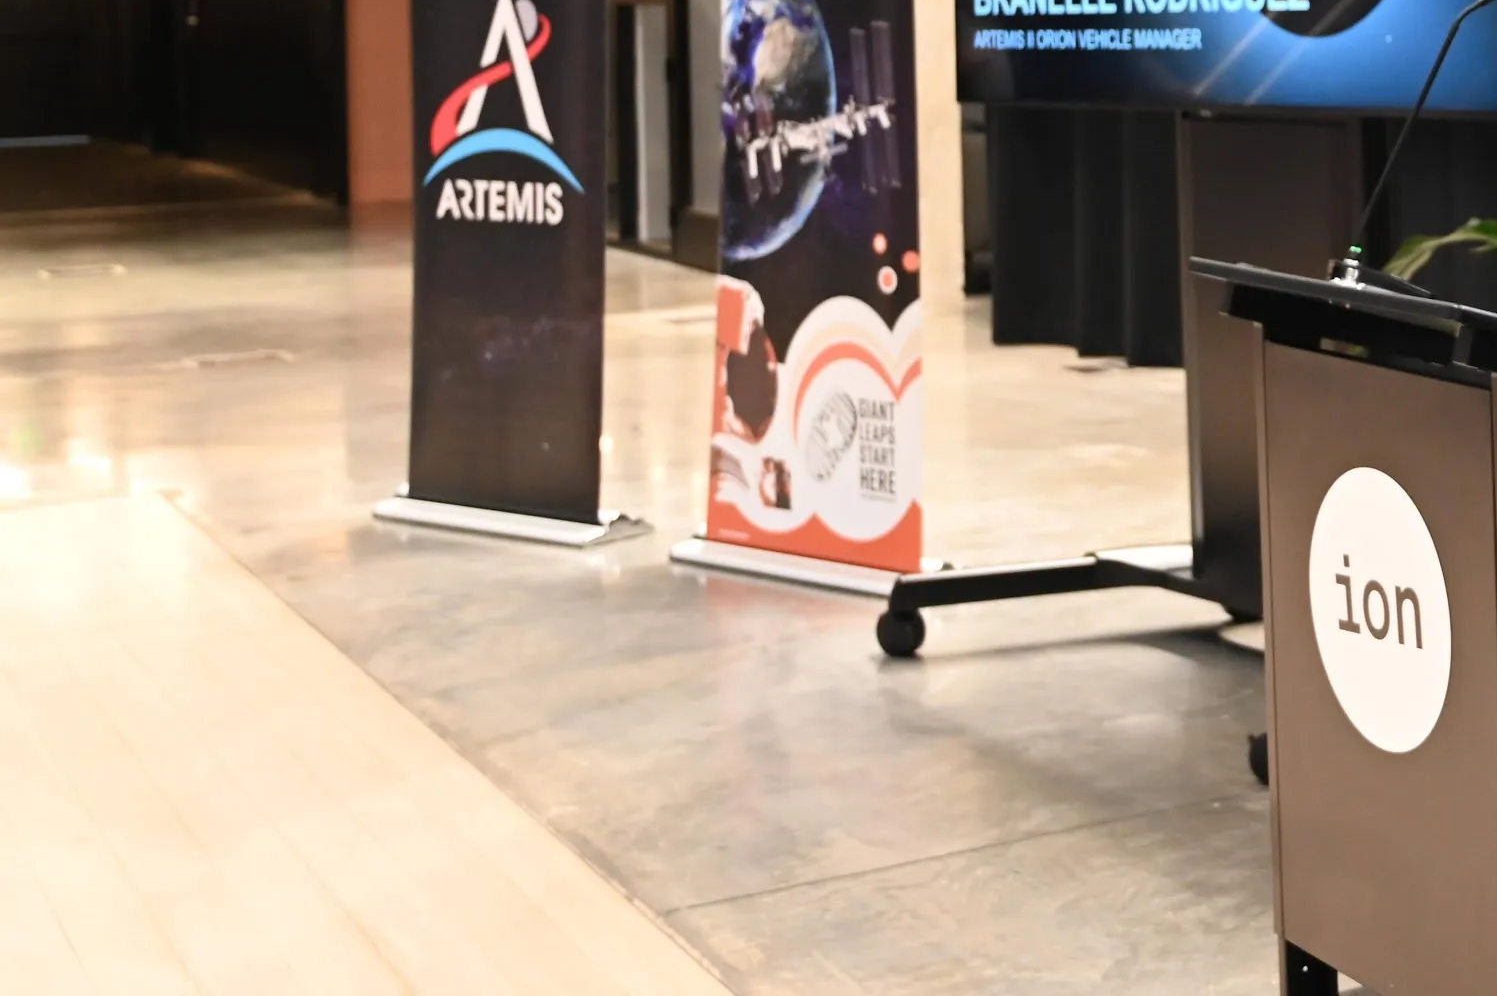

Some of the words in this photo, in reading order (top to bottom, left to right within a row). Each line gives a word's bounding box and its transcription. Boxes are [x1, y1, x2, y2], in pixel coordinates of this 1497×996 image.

[972, 28, 1025, 50] ARTEMIS
[1036, 28, 1077, 50] ORION
[1078, 27, 1132, 51] VEHICLE
[1133, 27, 1203, 51] MANAGER
[435, 177, 565, 227] ARTEMIS
[859, 398, 896, 422] GIANT
[859, 422, 897, 445] LEAPS
[859, 444, 896, 468] START
[860, 467, 897, 495] HERE
[1335, 553, 1423, 650] ion
